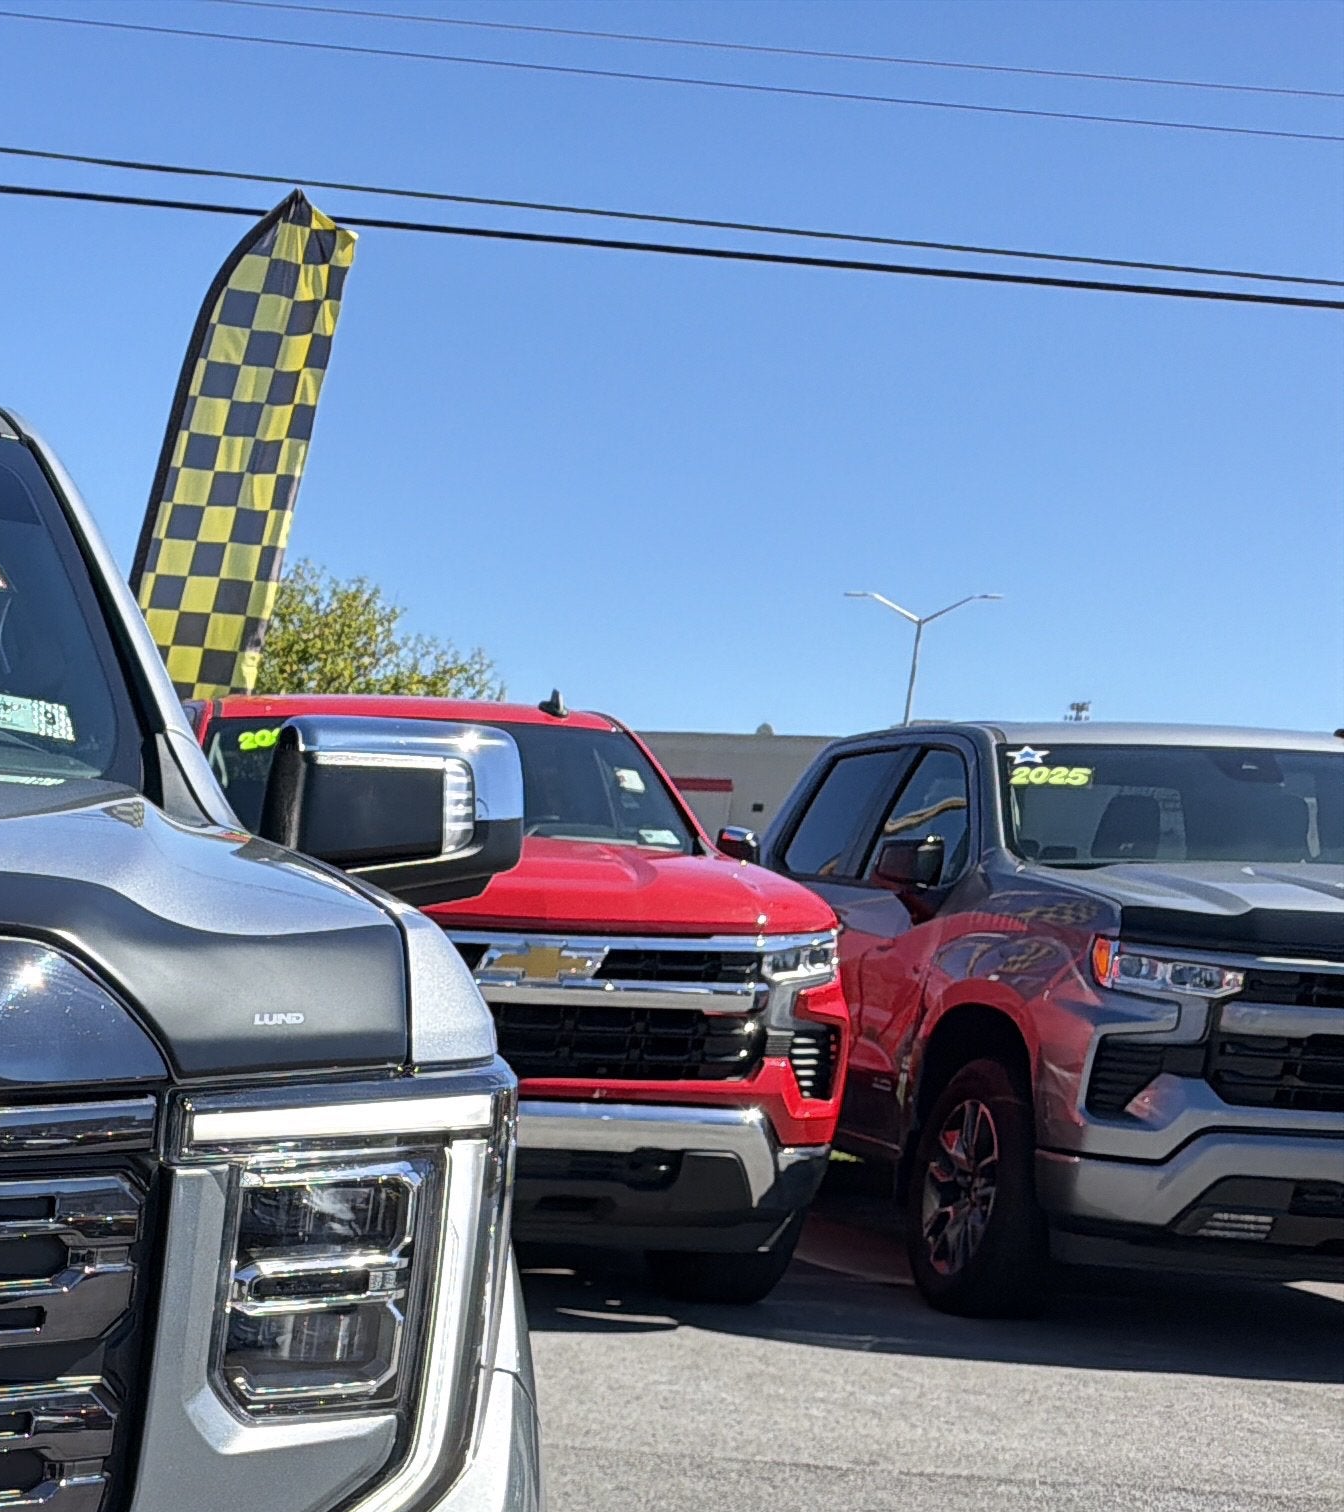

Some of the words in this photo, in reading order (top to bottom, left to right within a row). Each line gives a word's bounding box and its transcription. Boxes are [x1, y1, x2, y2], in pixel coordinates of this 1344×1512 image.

[44, 709, 57, 726] 9
[238, 727, 282, 750] 20
[1009, 766, 1092, 786] 2025
[253, 1012, 305, 1026] LUND
